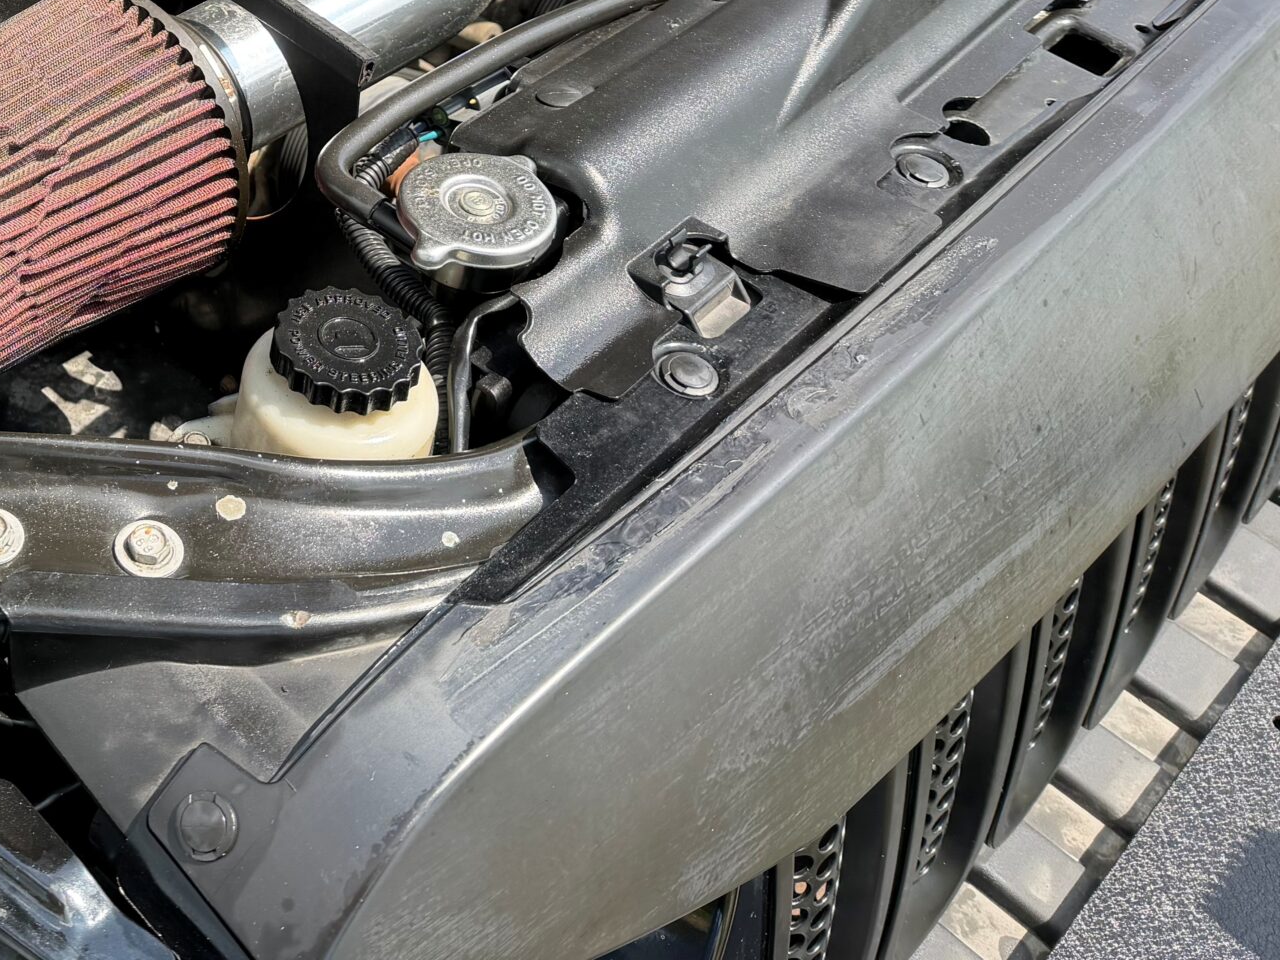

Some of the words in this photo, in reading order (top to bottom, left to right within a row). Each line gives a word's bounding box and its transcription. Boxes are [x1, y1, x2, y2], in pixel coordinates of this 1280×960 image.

[514, 175, 535, 191] DO
[531, 191, 547, 219] NOT
[462, 228, 496, 243] HOT
[502, 219, 539, 242] OPEN
[314, 293, 393, 321] APPROVED
[287, 327, 325, 373] POWER
[327, 360, 404, 385] STEERING
